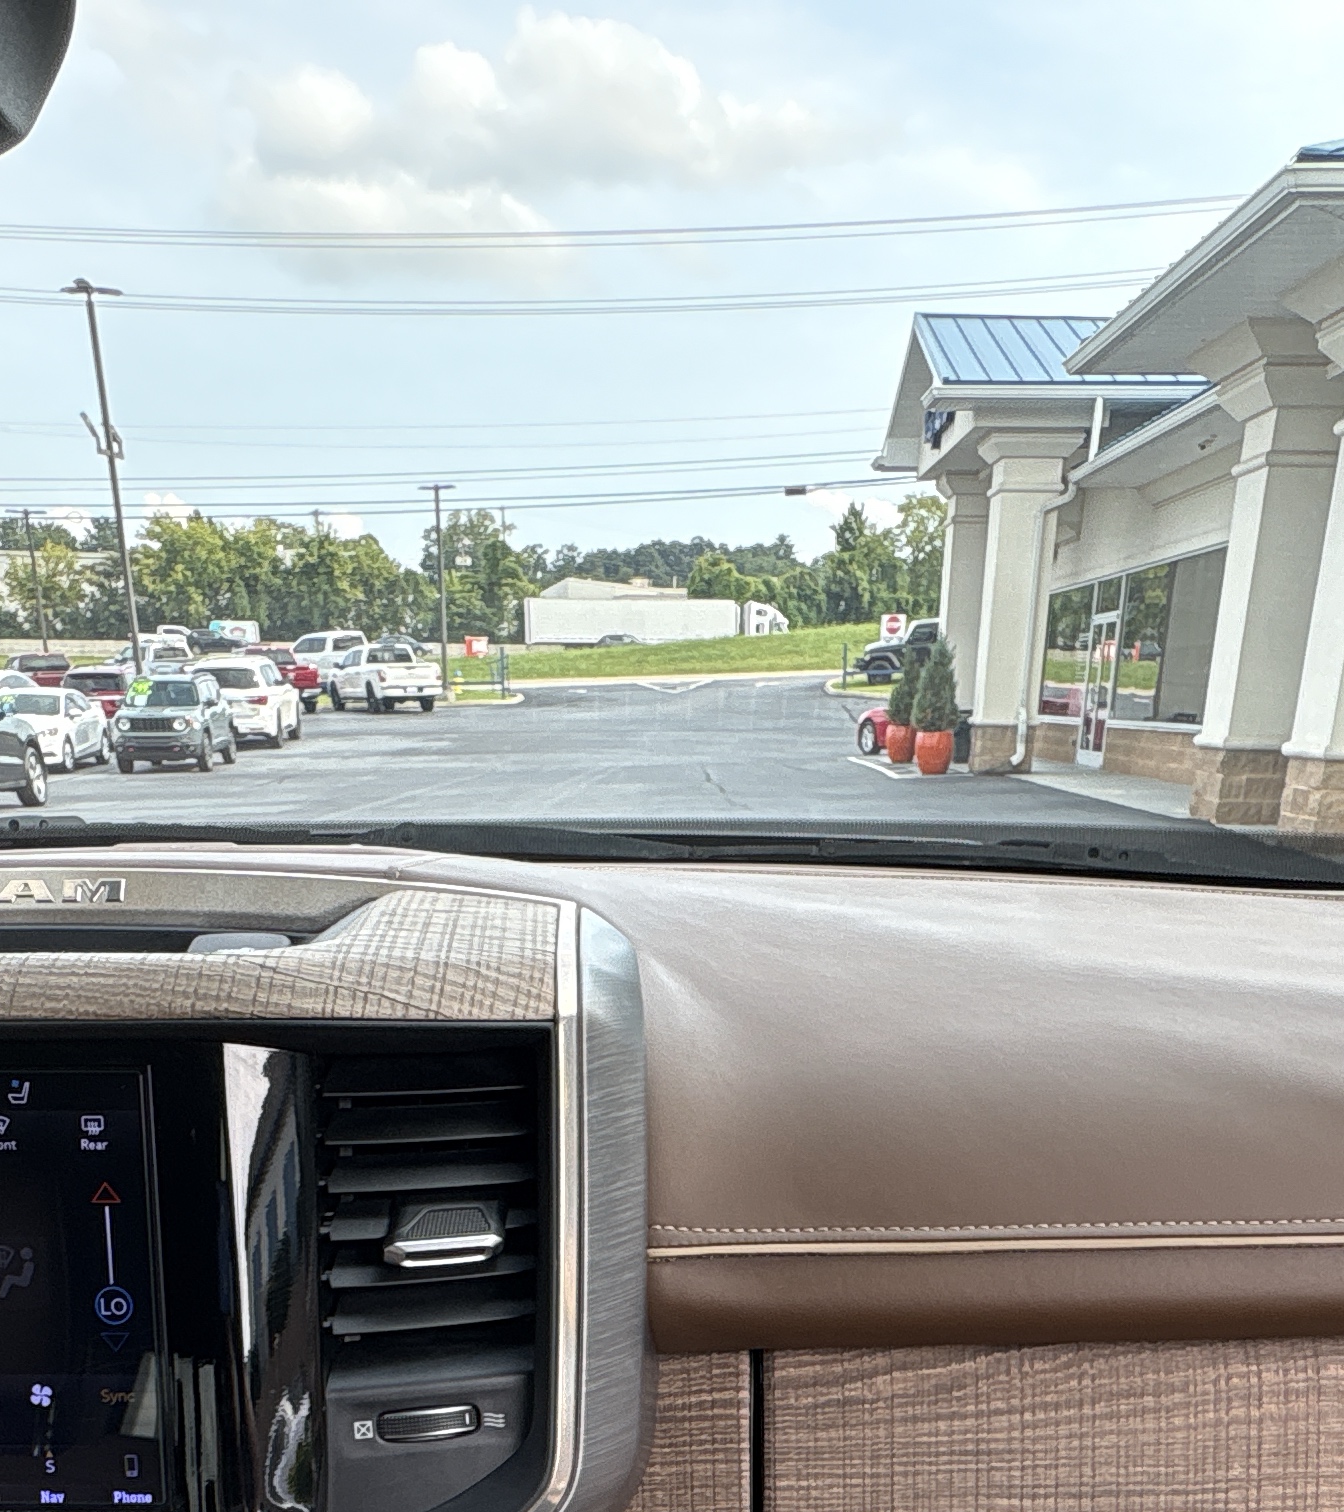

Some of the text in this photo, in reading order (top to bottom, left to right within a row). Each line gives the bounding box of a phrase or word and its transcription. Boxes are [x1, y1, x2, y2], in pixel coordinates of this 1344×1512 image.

[80, 1139, 108, 1151] Rear
[99, 1297, 127, 1316] LO
[100, 1389, 135, 1404] Sync
[40, 1491, 65, 1504] Nav
[113, 1490, 153, 1503] Phone
